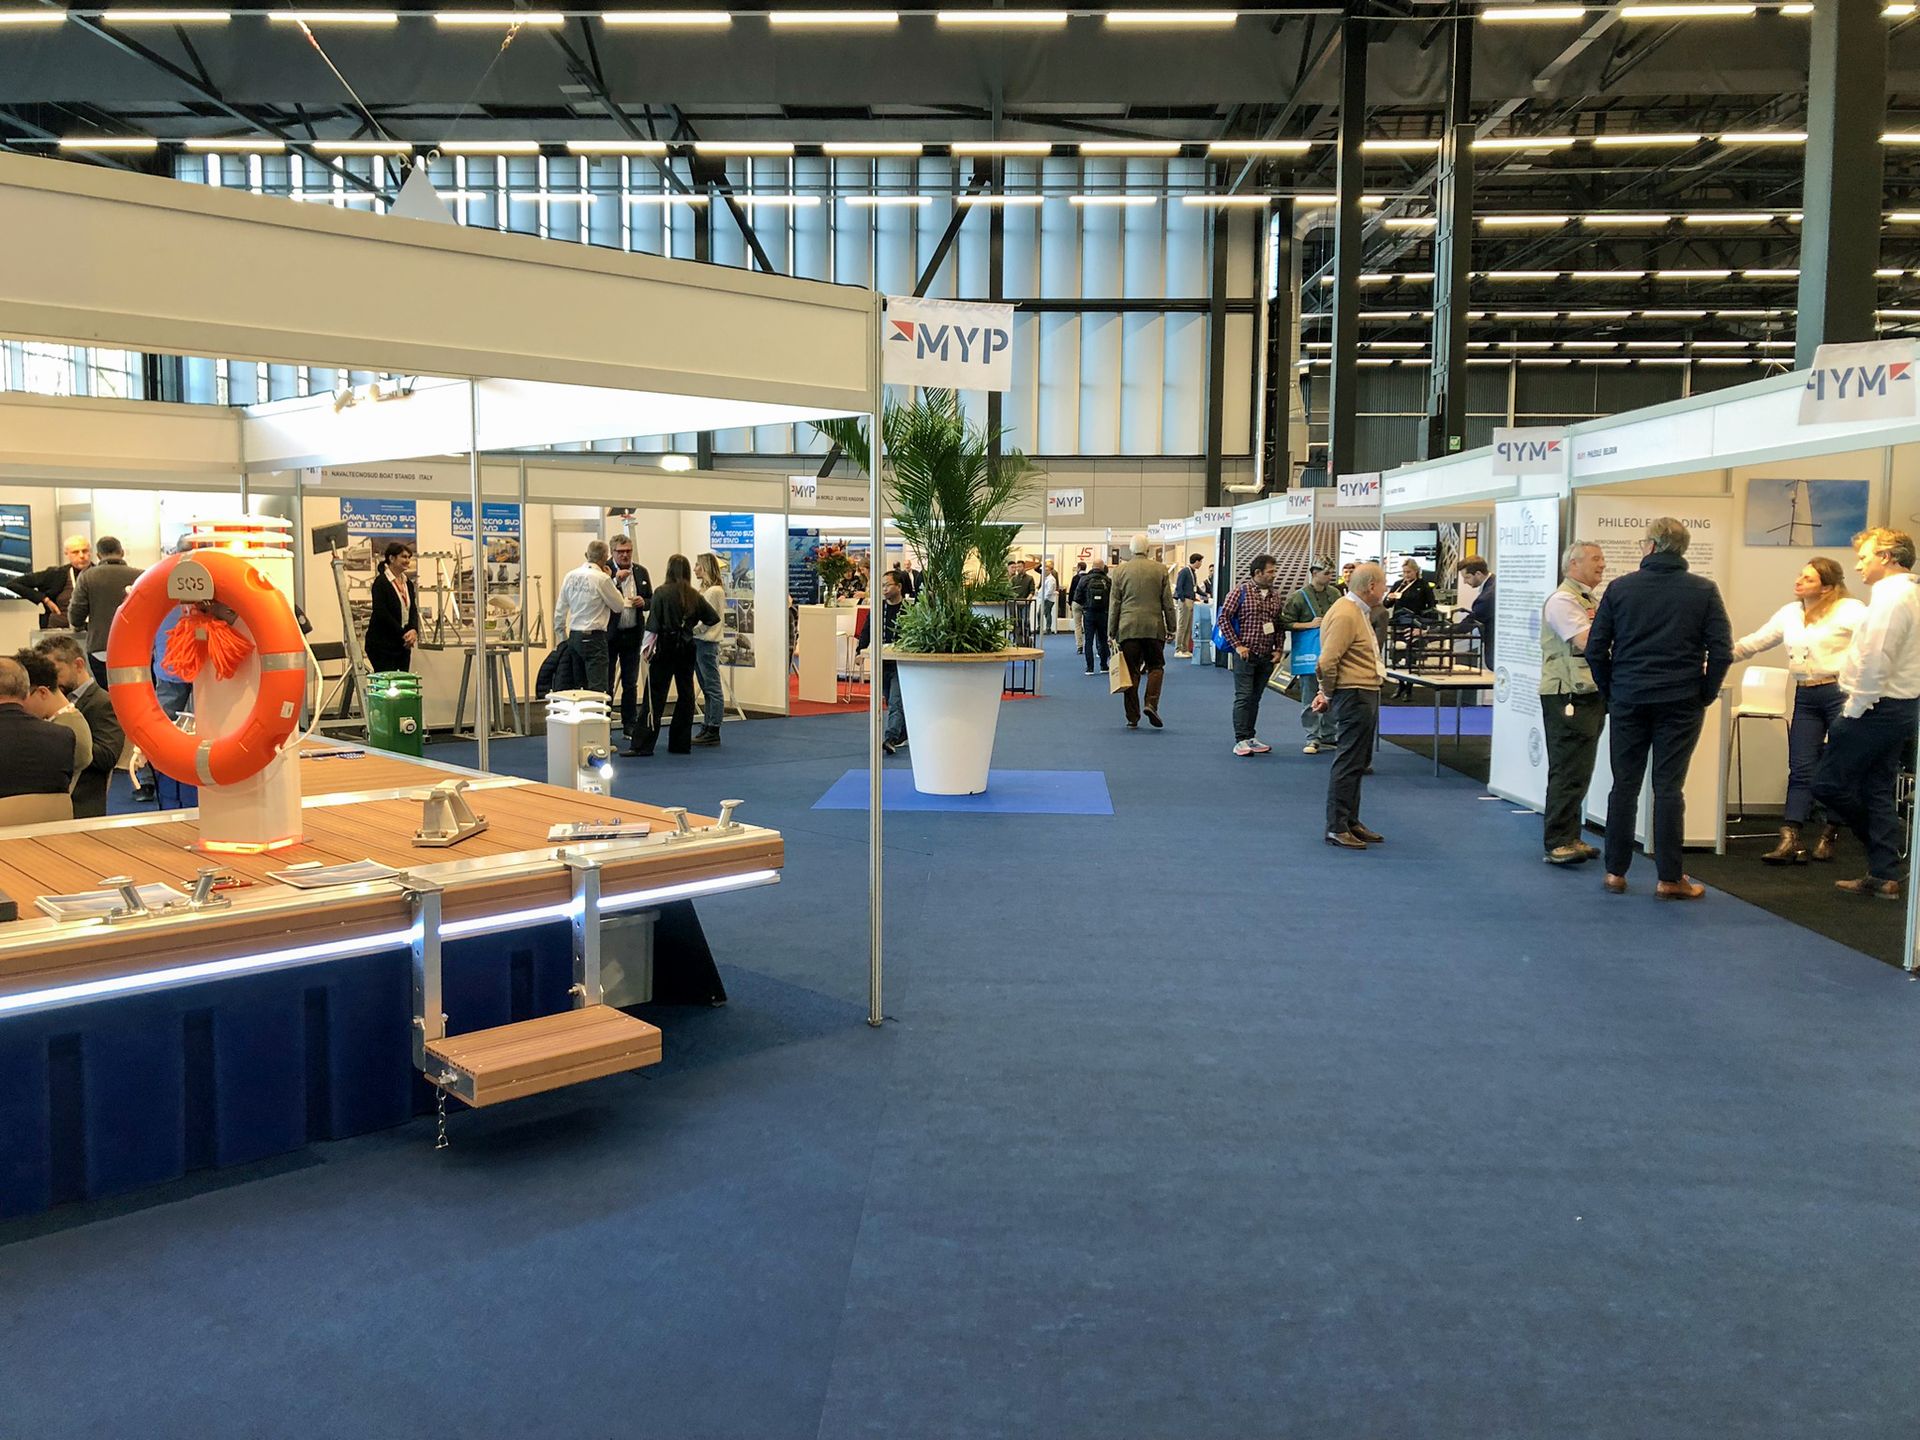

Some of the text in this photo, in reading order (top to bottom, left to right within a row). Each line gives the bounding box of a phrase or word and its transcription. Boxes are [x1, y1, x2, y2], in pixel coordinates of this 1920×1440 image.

[917, 323, 1009, 364] MYP
[795, 485, 815, 497] MYP
[1056, 496, 1082, 507] MYP
[177, 577, 205, 591] SOS
